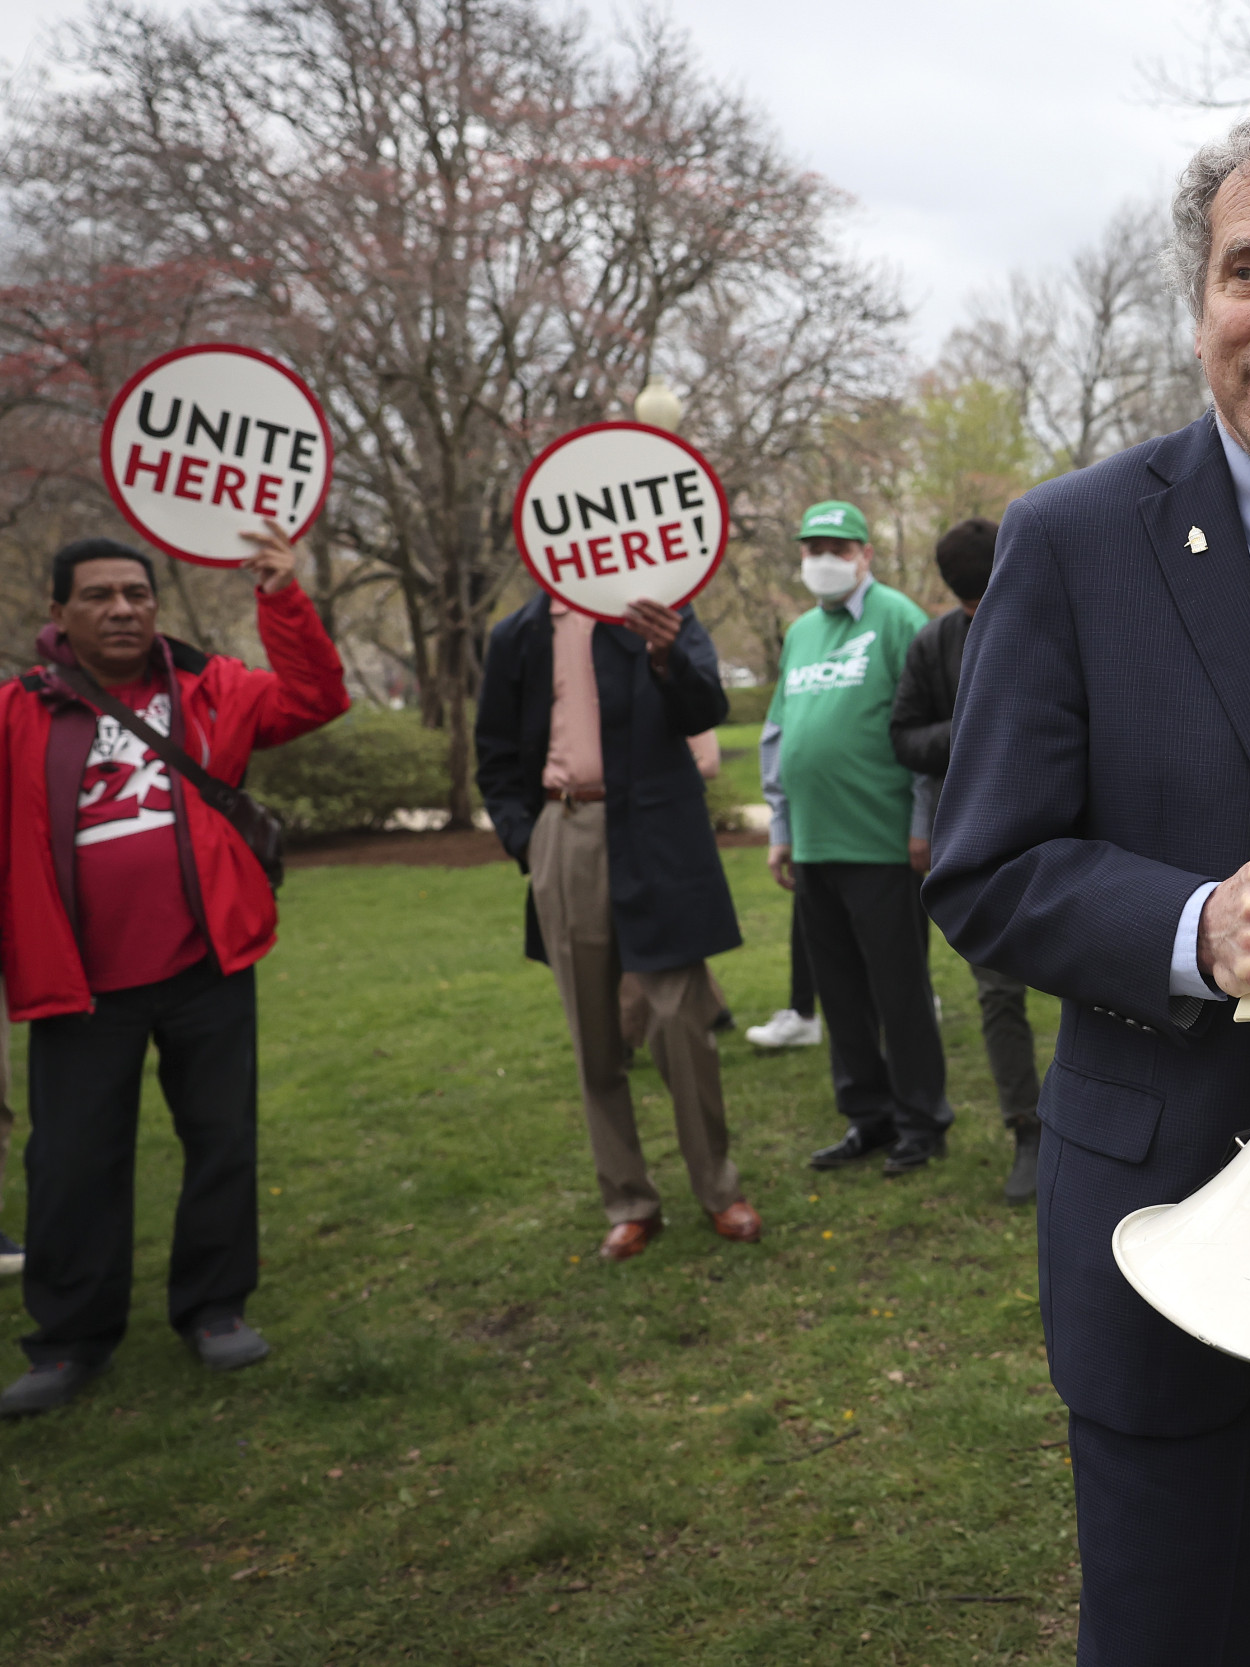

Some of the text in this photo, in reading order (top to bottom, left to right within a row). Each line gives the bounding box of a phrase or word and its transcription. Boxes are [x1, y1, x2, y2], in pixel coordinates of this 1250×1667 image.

[137, 390, 318, 473] UNITE
[123, 443, 305, 523] HERE!
[532, 469, 704, 535] UNITE
[544, 515, 709, 583] HERE!
